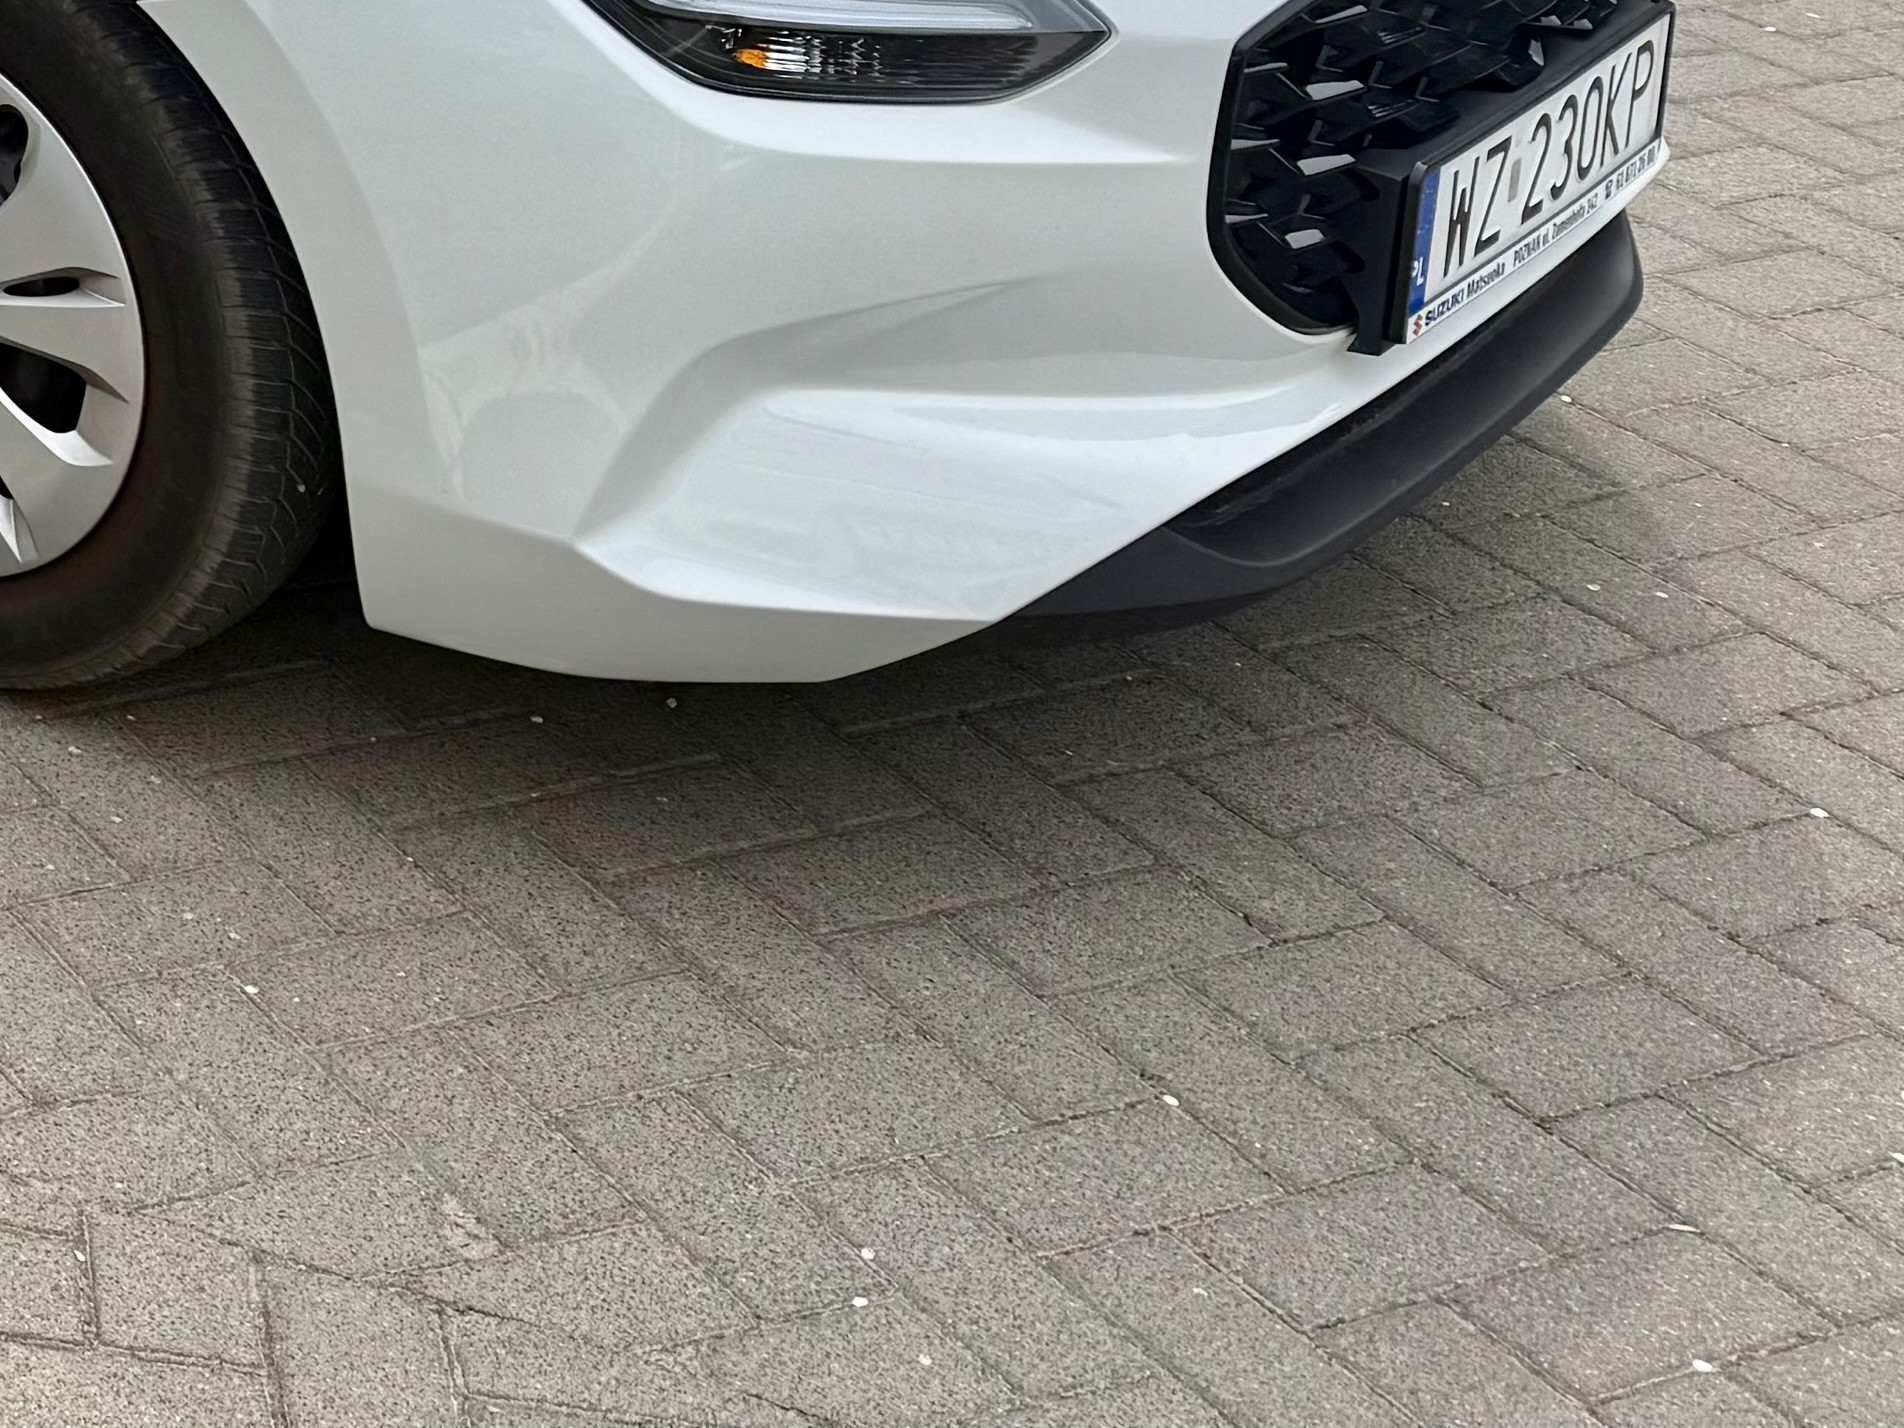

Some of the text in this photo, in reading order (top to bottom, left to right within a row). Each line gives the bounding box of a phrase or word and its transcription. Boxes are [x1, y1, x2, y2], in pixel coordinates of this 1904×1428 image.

[1443, 39, 1655, 278] WZ 230KP
[1425, 287, 1465, 327] SUZUKI
